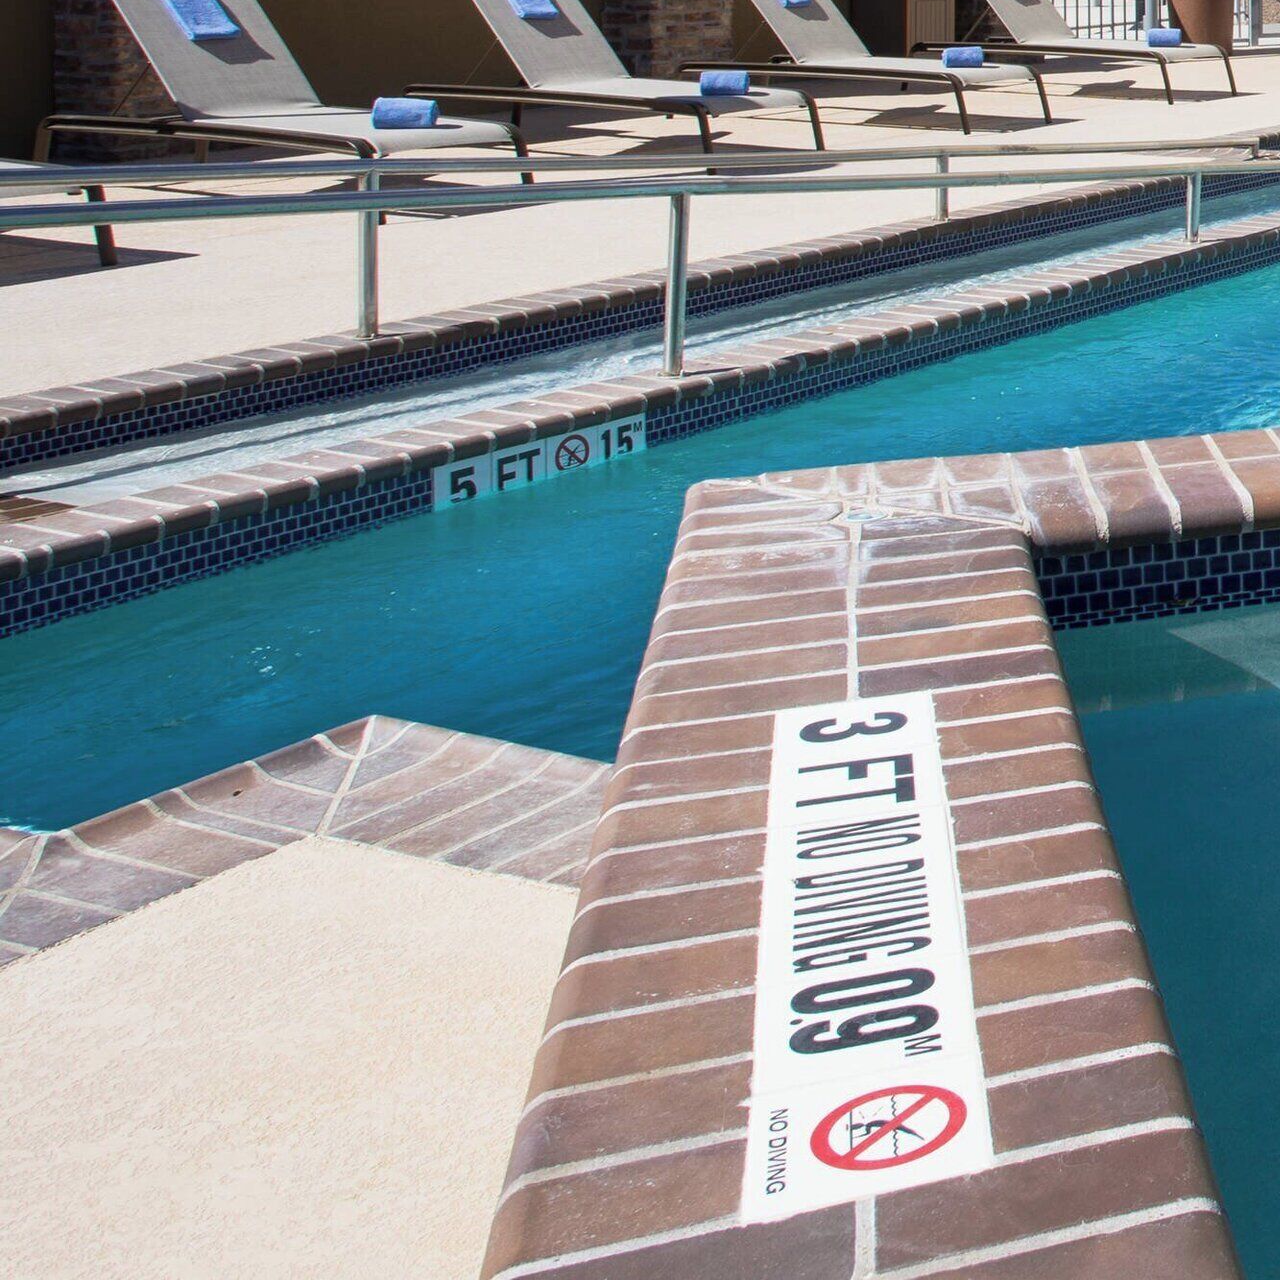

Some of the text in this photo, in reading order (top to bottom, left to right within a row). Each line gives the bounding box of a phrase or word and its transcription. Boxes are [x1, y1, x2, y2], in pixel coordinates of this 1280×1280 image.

[450, 466, 477, 503] 5
[497, 448, 541, 491] FT
[798, 711, 909, 744] 3
[796, 753, 916, 809] FT
[796, 813, 922, 859] NO
[792, 857, 932, 973] DIVING
[766, 1108, 789, 1195] NO DIVING
